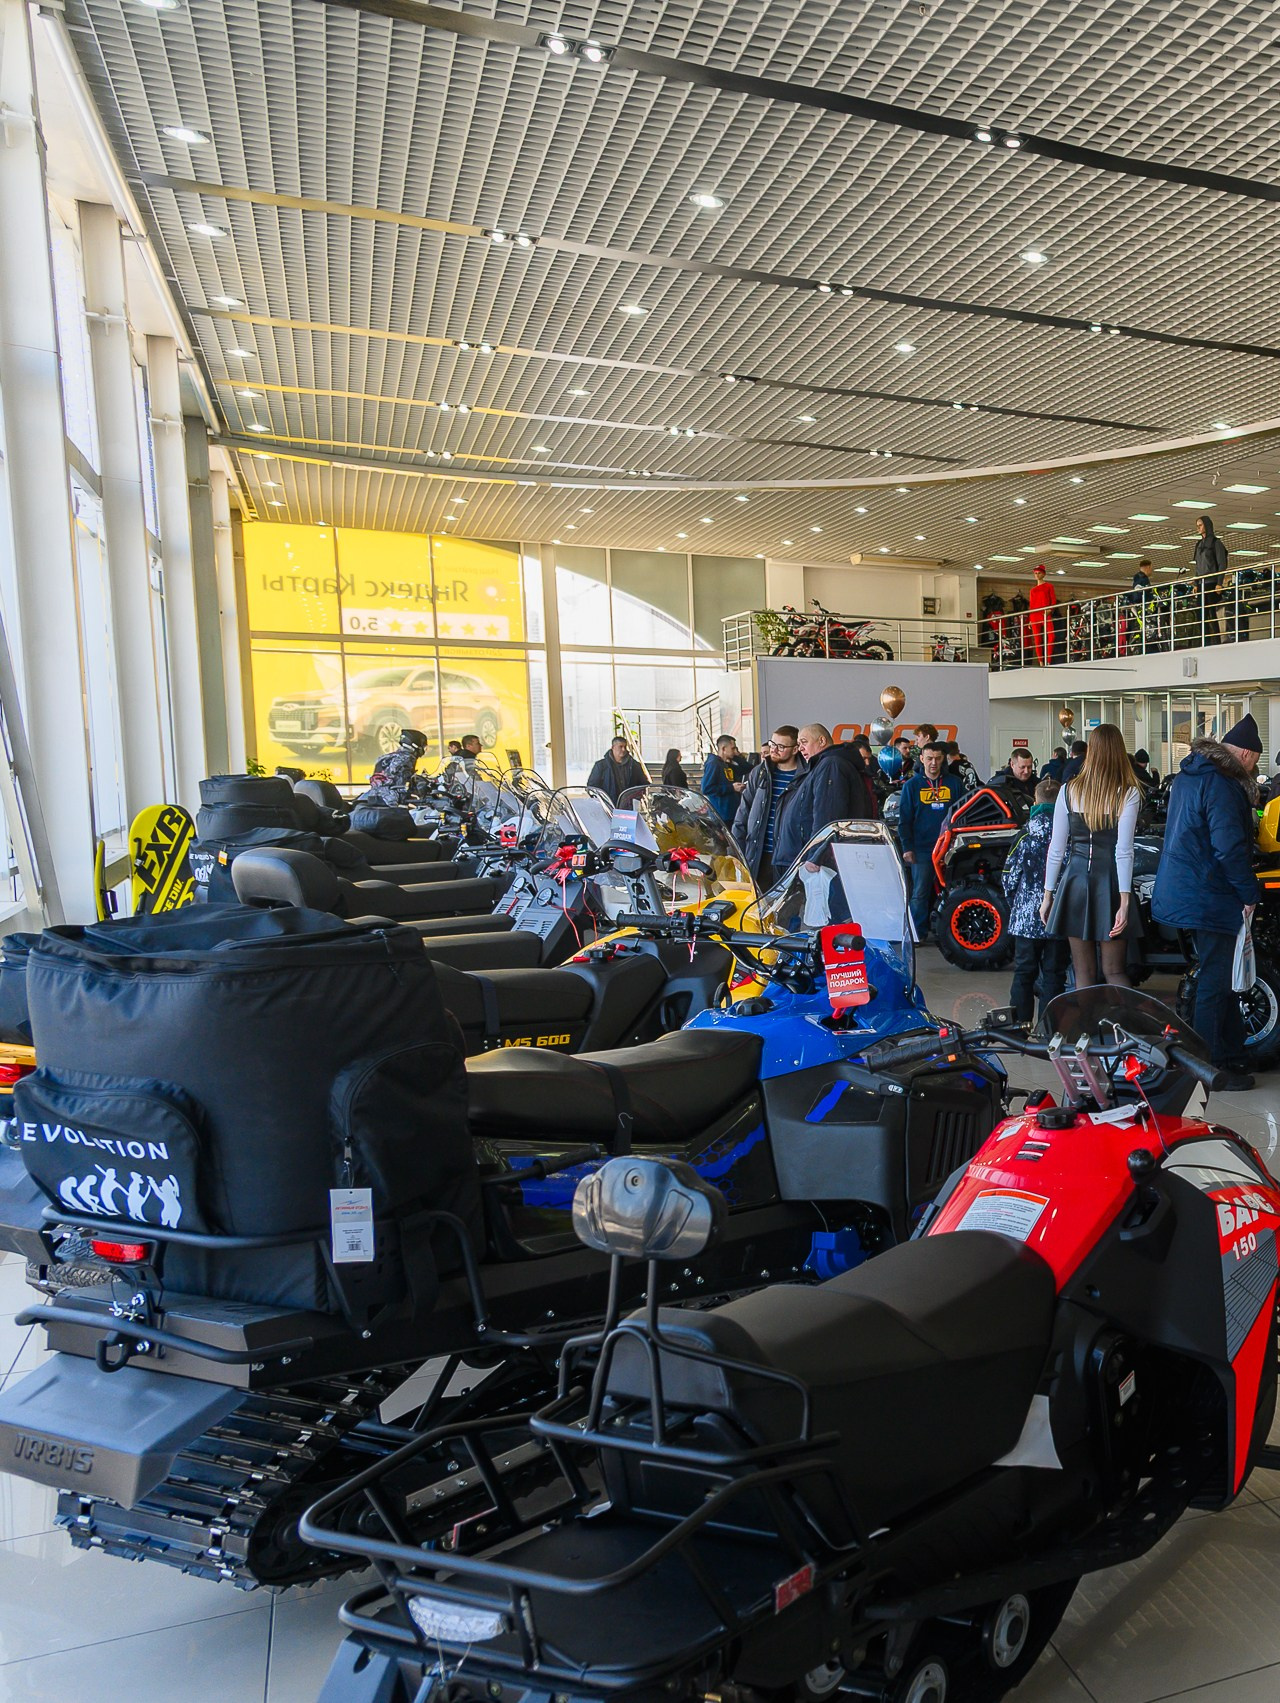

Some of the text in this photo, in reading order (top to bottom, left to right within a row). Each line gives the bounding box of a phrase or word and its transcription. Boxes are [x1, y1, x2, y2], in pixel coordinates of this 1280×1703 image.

[135, 806, 184, 891] FXR
[829, 977, 865, 989] ПОДАРОК
[830, 968, 863, 981] ЛУЧШИЙ
[536, 1034, 571, 1047] 600
[1217, 1192, 1275, 1237] БАРС
[1232, 1232, 1257, 1260] 150
[14, 1433, 95, 1475] IRBIS
